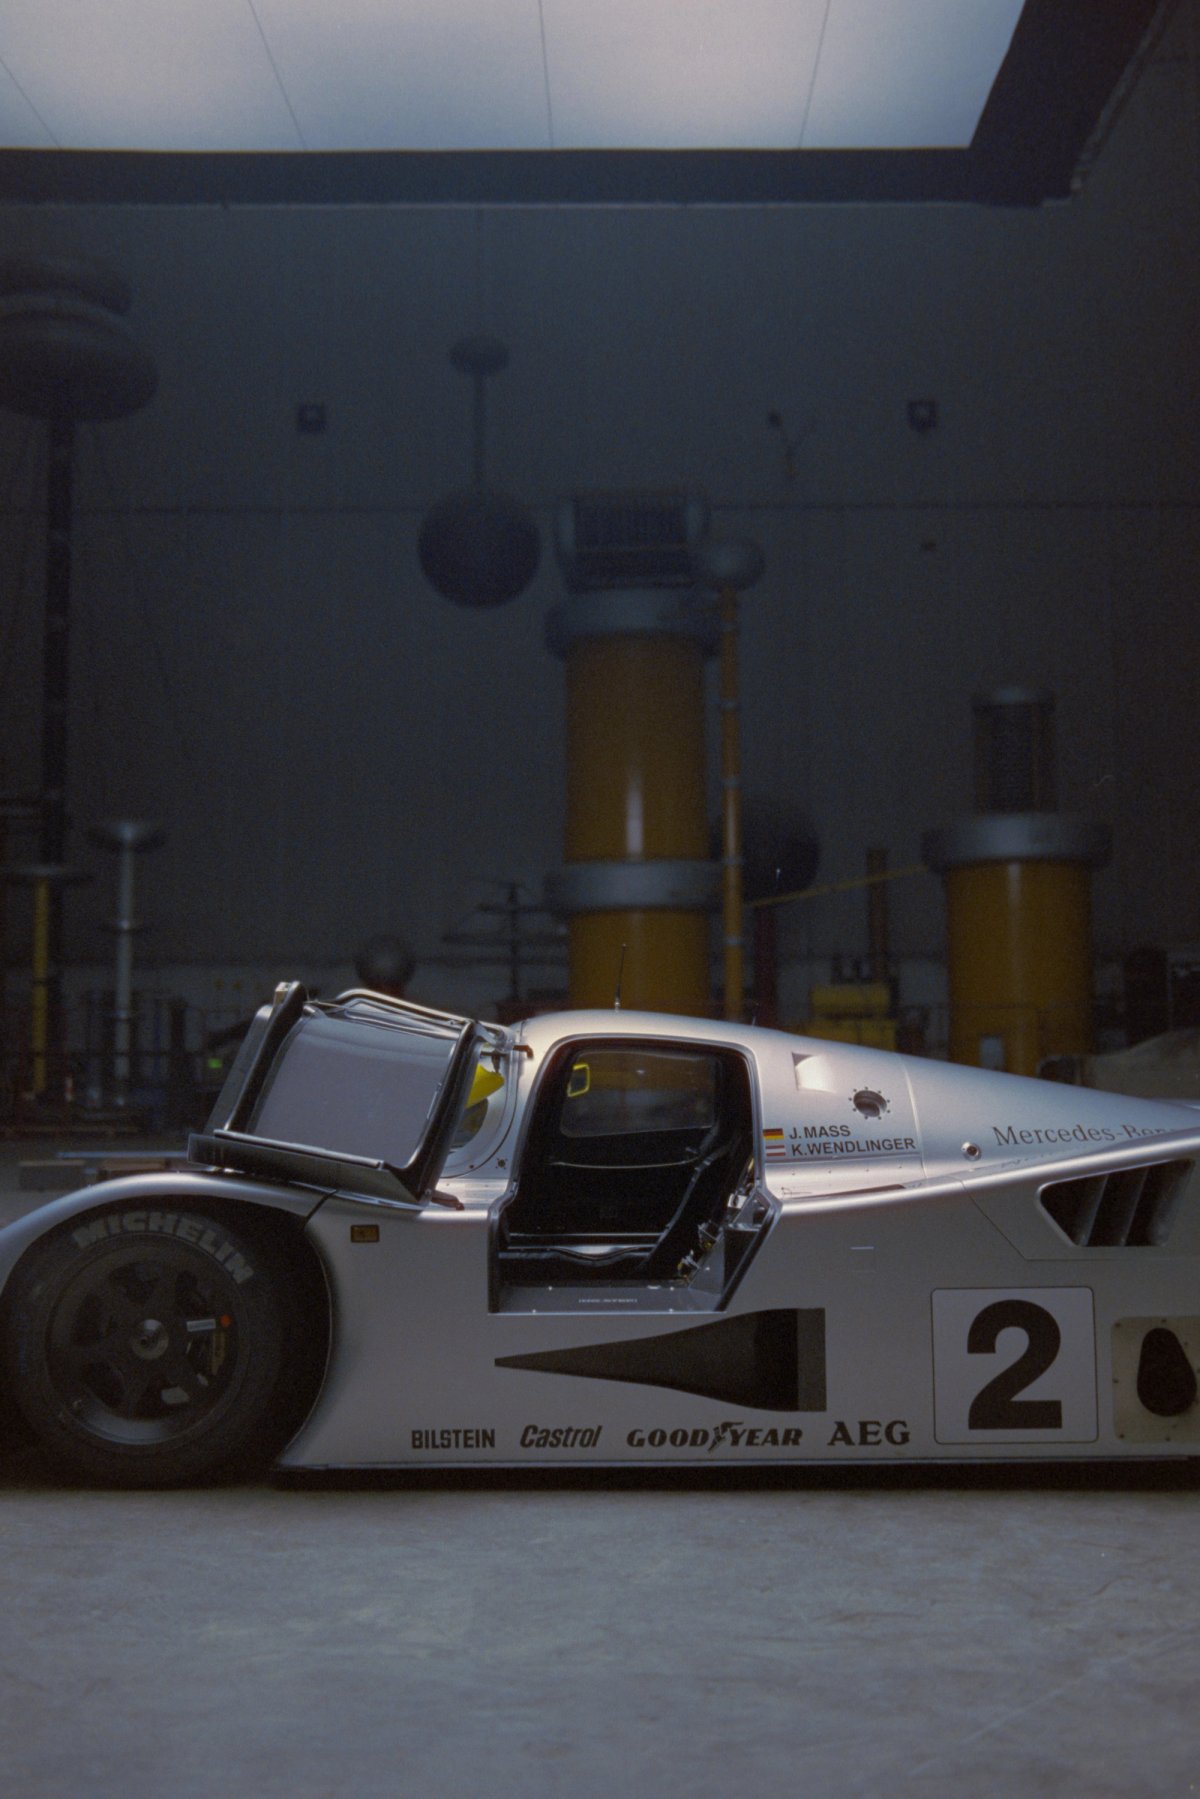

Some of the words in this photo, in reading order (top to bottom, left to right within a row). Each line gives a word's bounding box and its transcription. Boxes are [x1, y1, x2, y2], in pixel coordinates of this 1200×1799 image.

[792, 1138, 916, 1157] K.WENDLINGER
[73, 1211, 254, 1284] MICHELIN
[967, 1299, 1063, 1430] 2
[411, 1429, 496, 1450] BILSTEIN
[519, 1424, 602, 1449] Castrol
[827, 1420, 911, 1446] AEG
